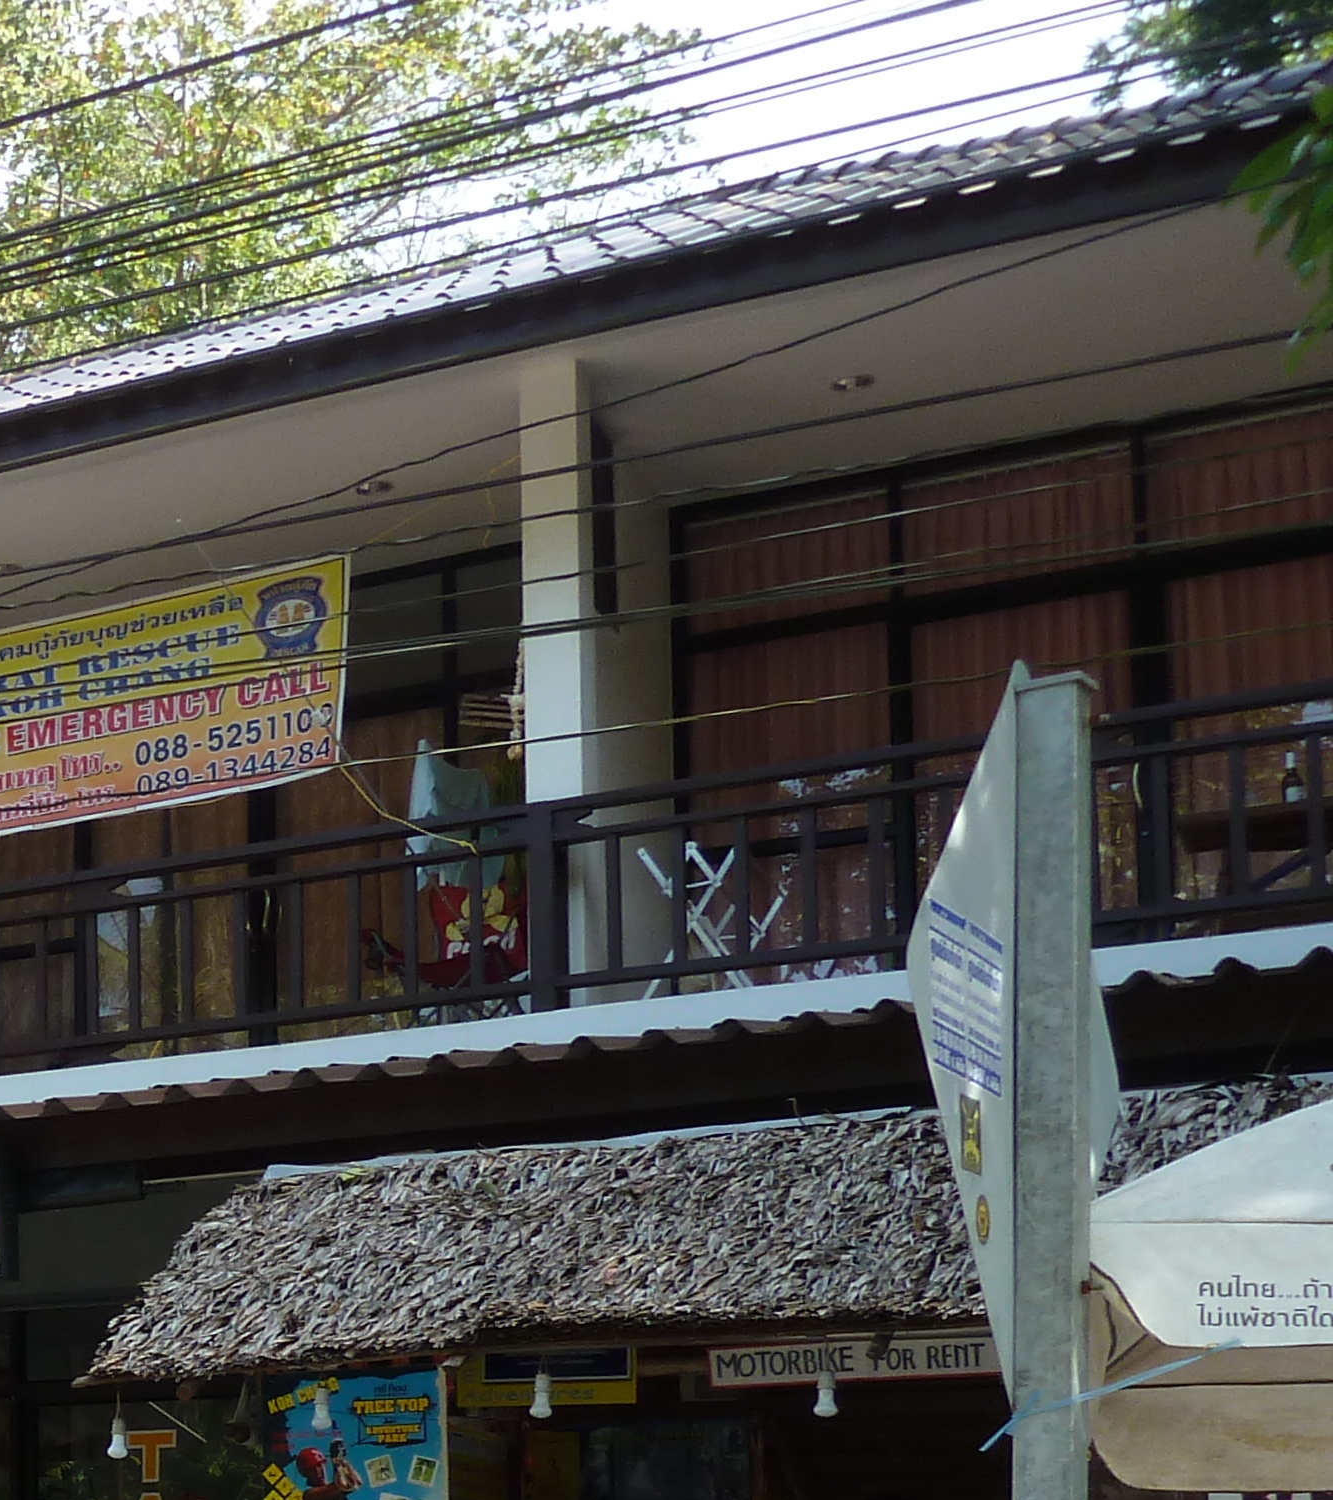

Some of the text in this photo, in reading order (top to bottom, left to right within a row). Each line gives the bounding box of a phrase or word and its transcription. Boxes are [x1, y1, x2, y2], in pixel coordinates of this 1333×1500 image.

[78, 624, 240, 677] RESCUE
[78, 657, 211, 701] CHANG
[6, 661, 331, 756] EMERGENCY CALL
[135, 735, 331, 797] 089-1344284
[716, 1343, 985, 1378] MOTORBIKE RENT
[354, 1398, 430, 1414] TREE TOP
